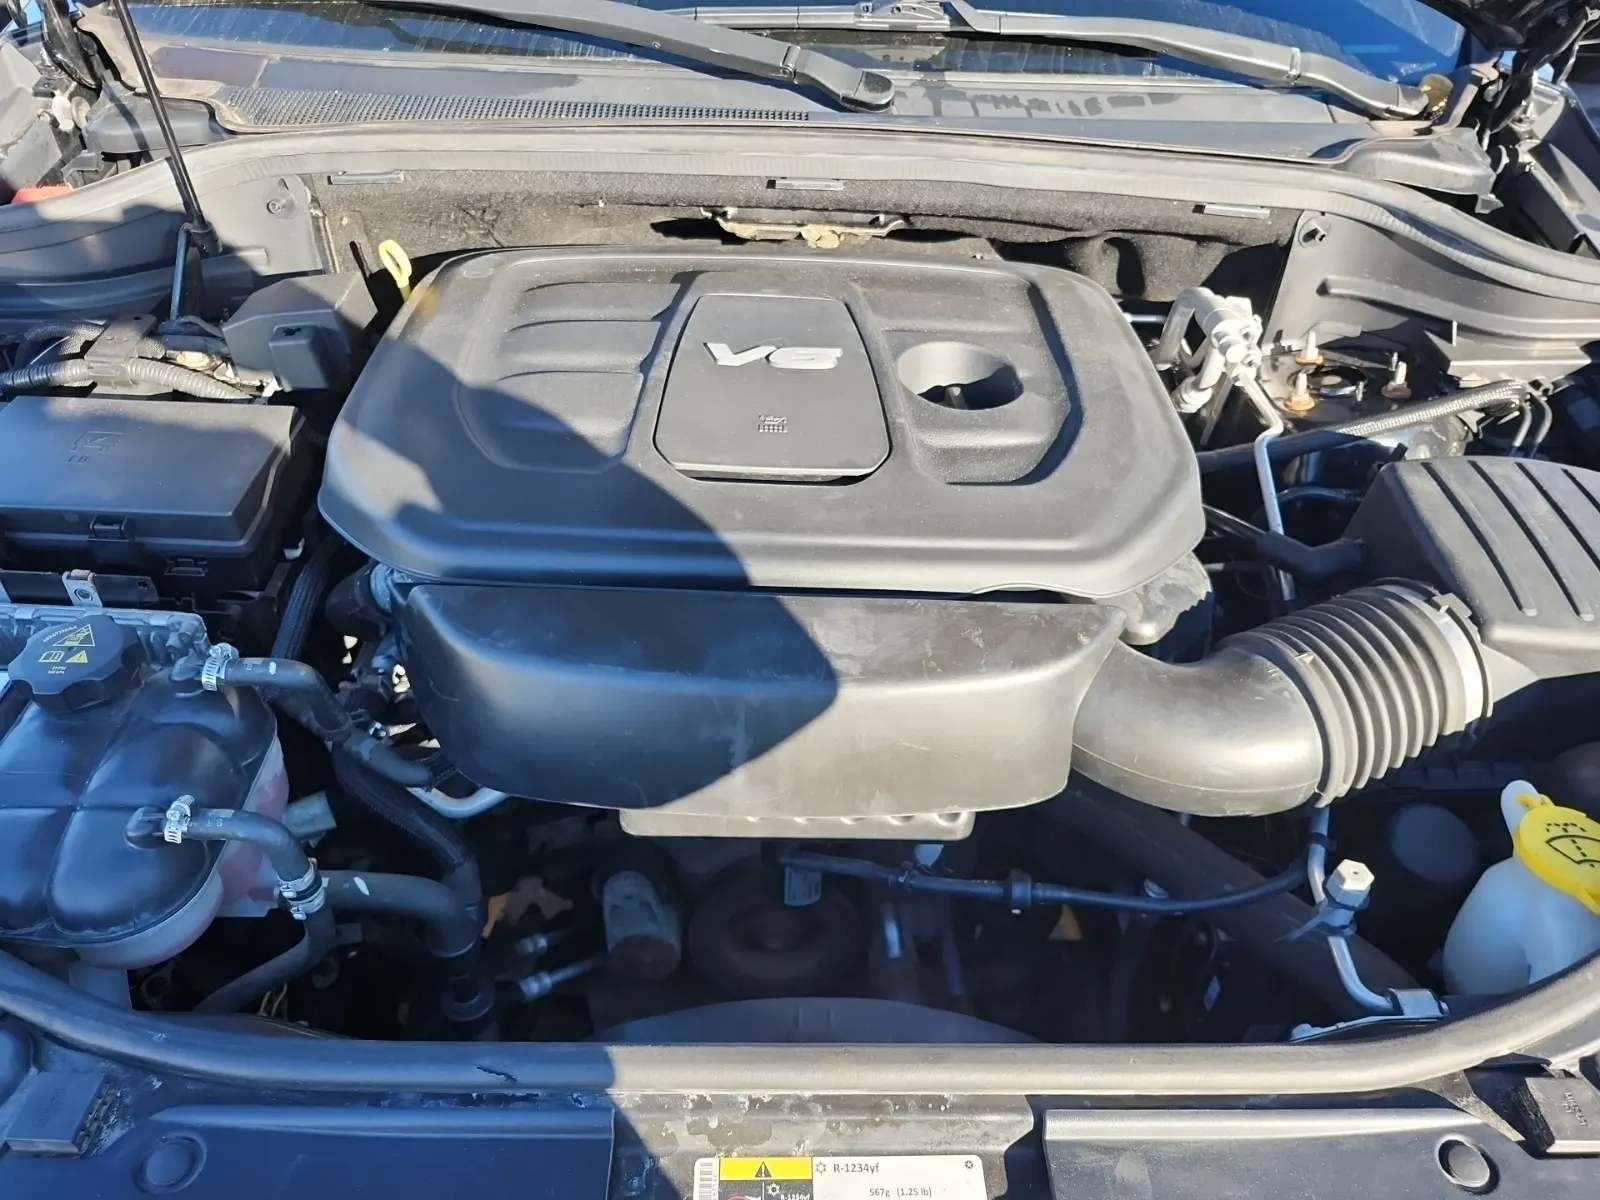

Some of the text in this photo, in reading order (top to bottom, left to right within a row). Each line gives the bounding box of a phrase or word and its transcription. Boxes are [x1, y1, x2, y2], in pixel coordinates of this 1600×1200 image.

[703, 342, 843, 369] V6
[833, 1163, 879, 1174] R-1234yf
[869, 1187, 932, 1198] 567g (1.25 lb)
